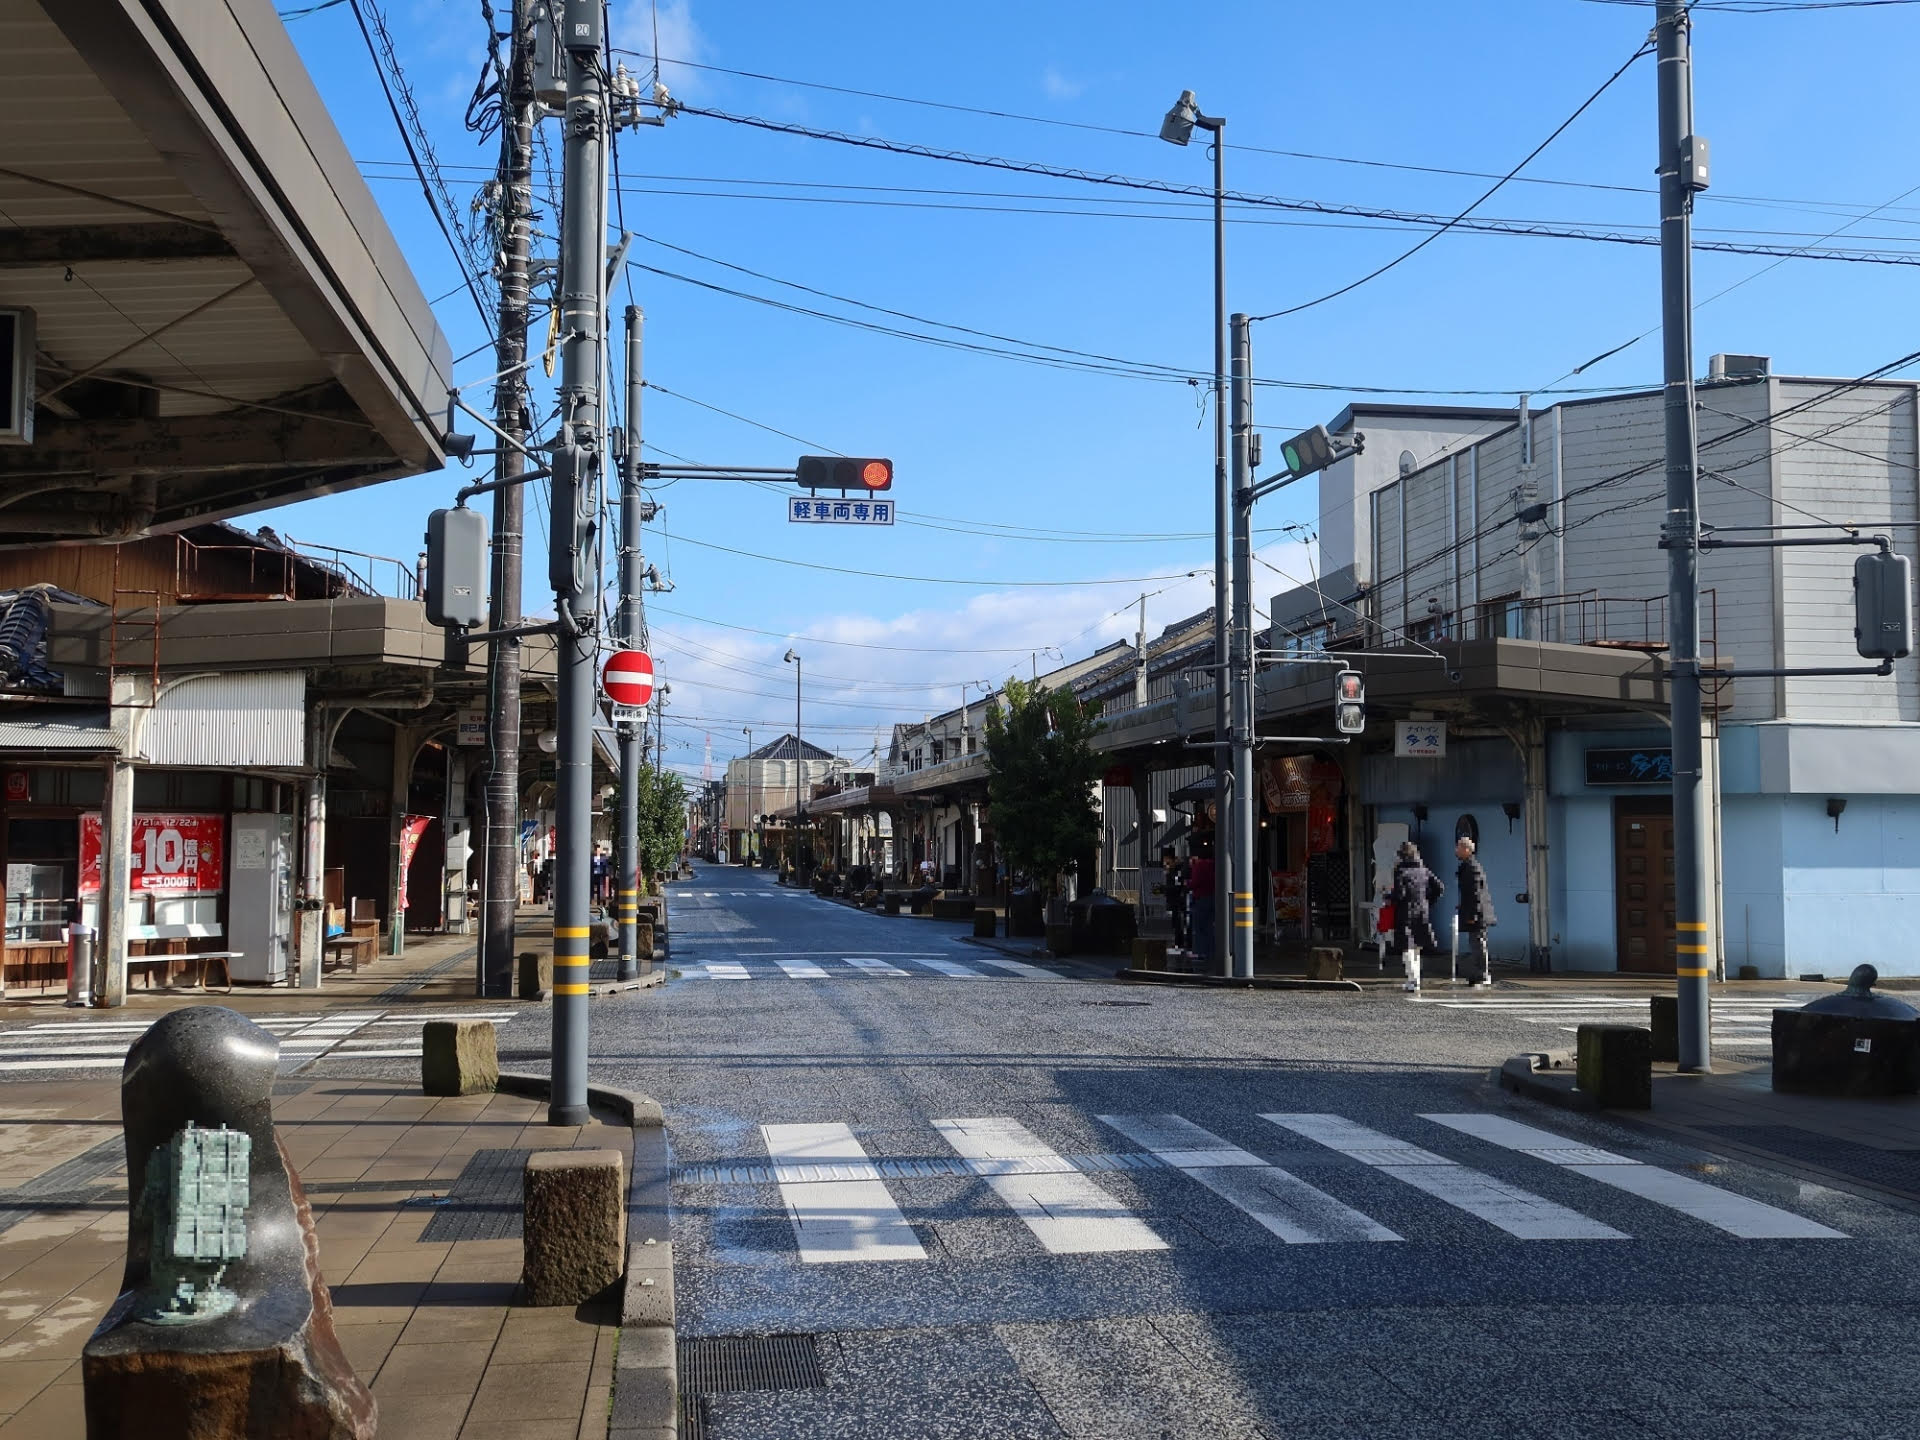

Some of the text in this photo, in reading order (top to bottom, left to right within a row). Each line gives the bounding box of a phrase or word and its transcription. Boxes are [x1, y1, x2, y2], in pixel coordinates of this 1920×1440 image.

[576, 24, 589, 36] 20
[793, 501, 889, 522] 軽車両専用
